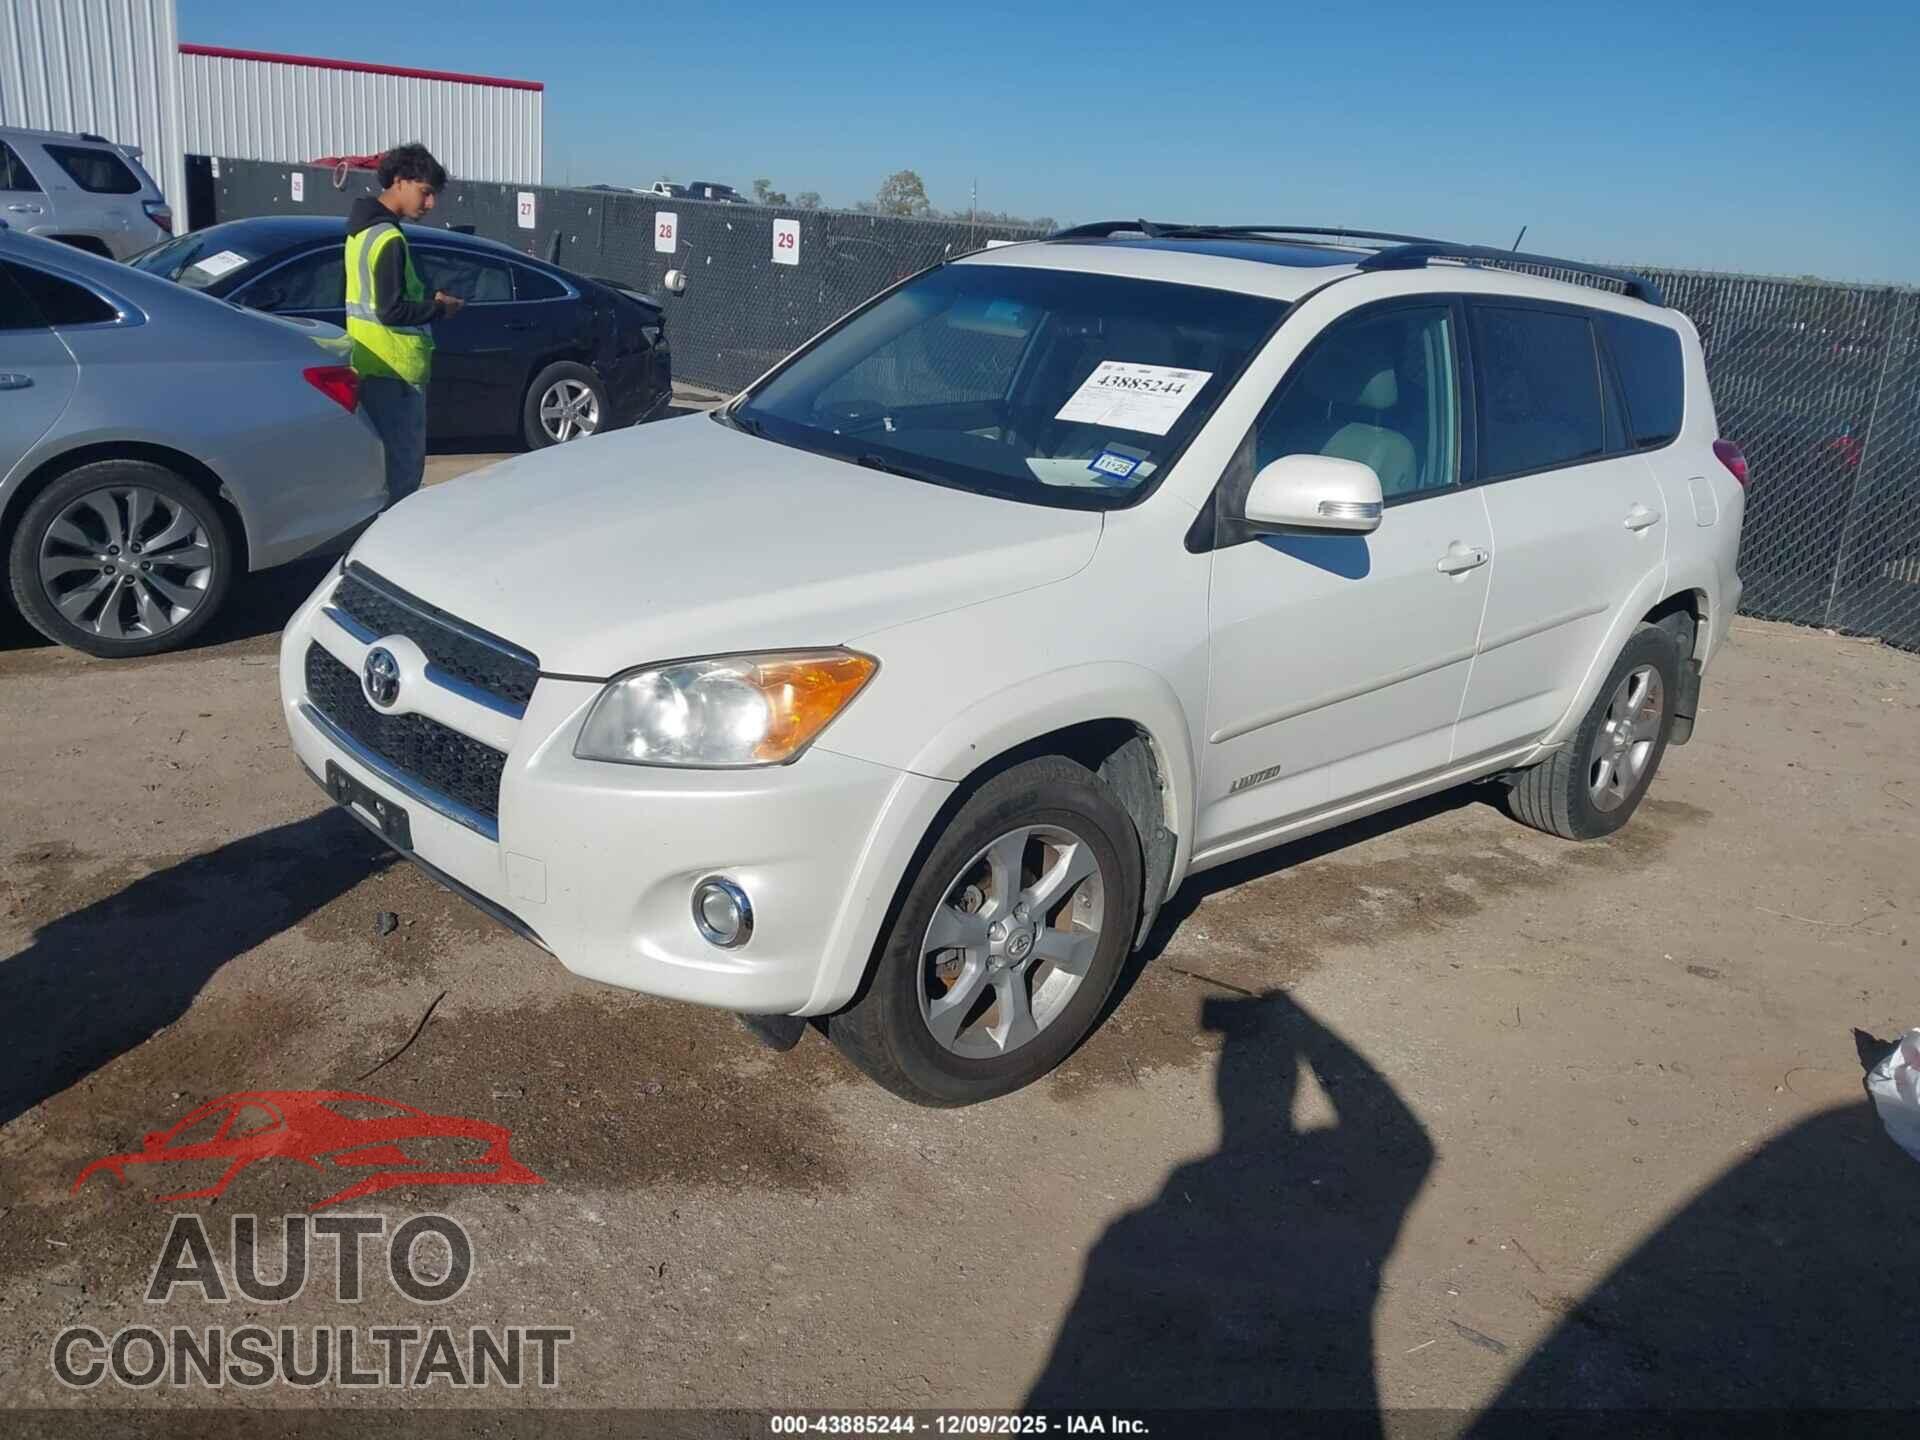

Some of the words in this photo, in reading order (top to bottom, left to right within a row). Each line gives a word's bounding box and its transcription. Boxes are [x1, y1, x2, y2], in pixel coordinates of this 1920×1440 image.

[521, 202, 532, 215] 27
[659, 224, 672, 239] 28
[778, 232, 794, 249] 29
[1097, 375, 1186, 395] 43885244
[1229, 765, 1281, 793] LIMITED
